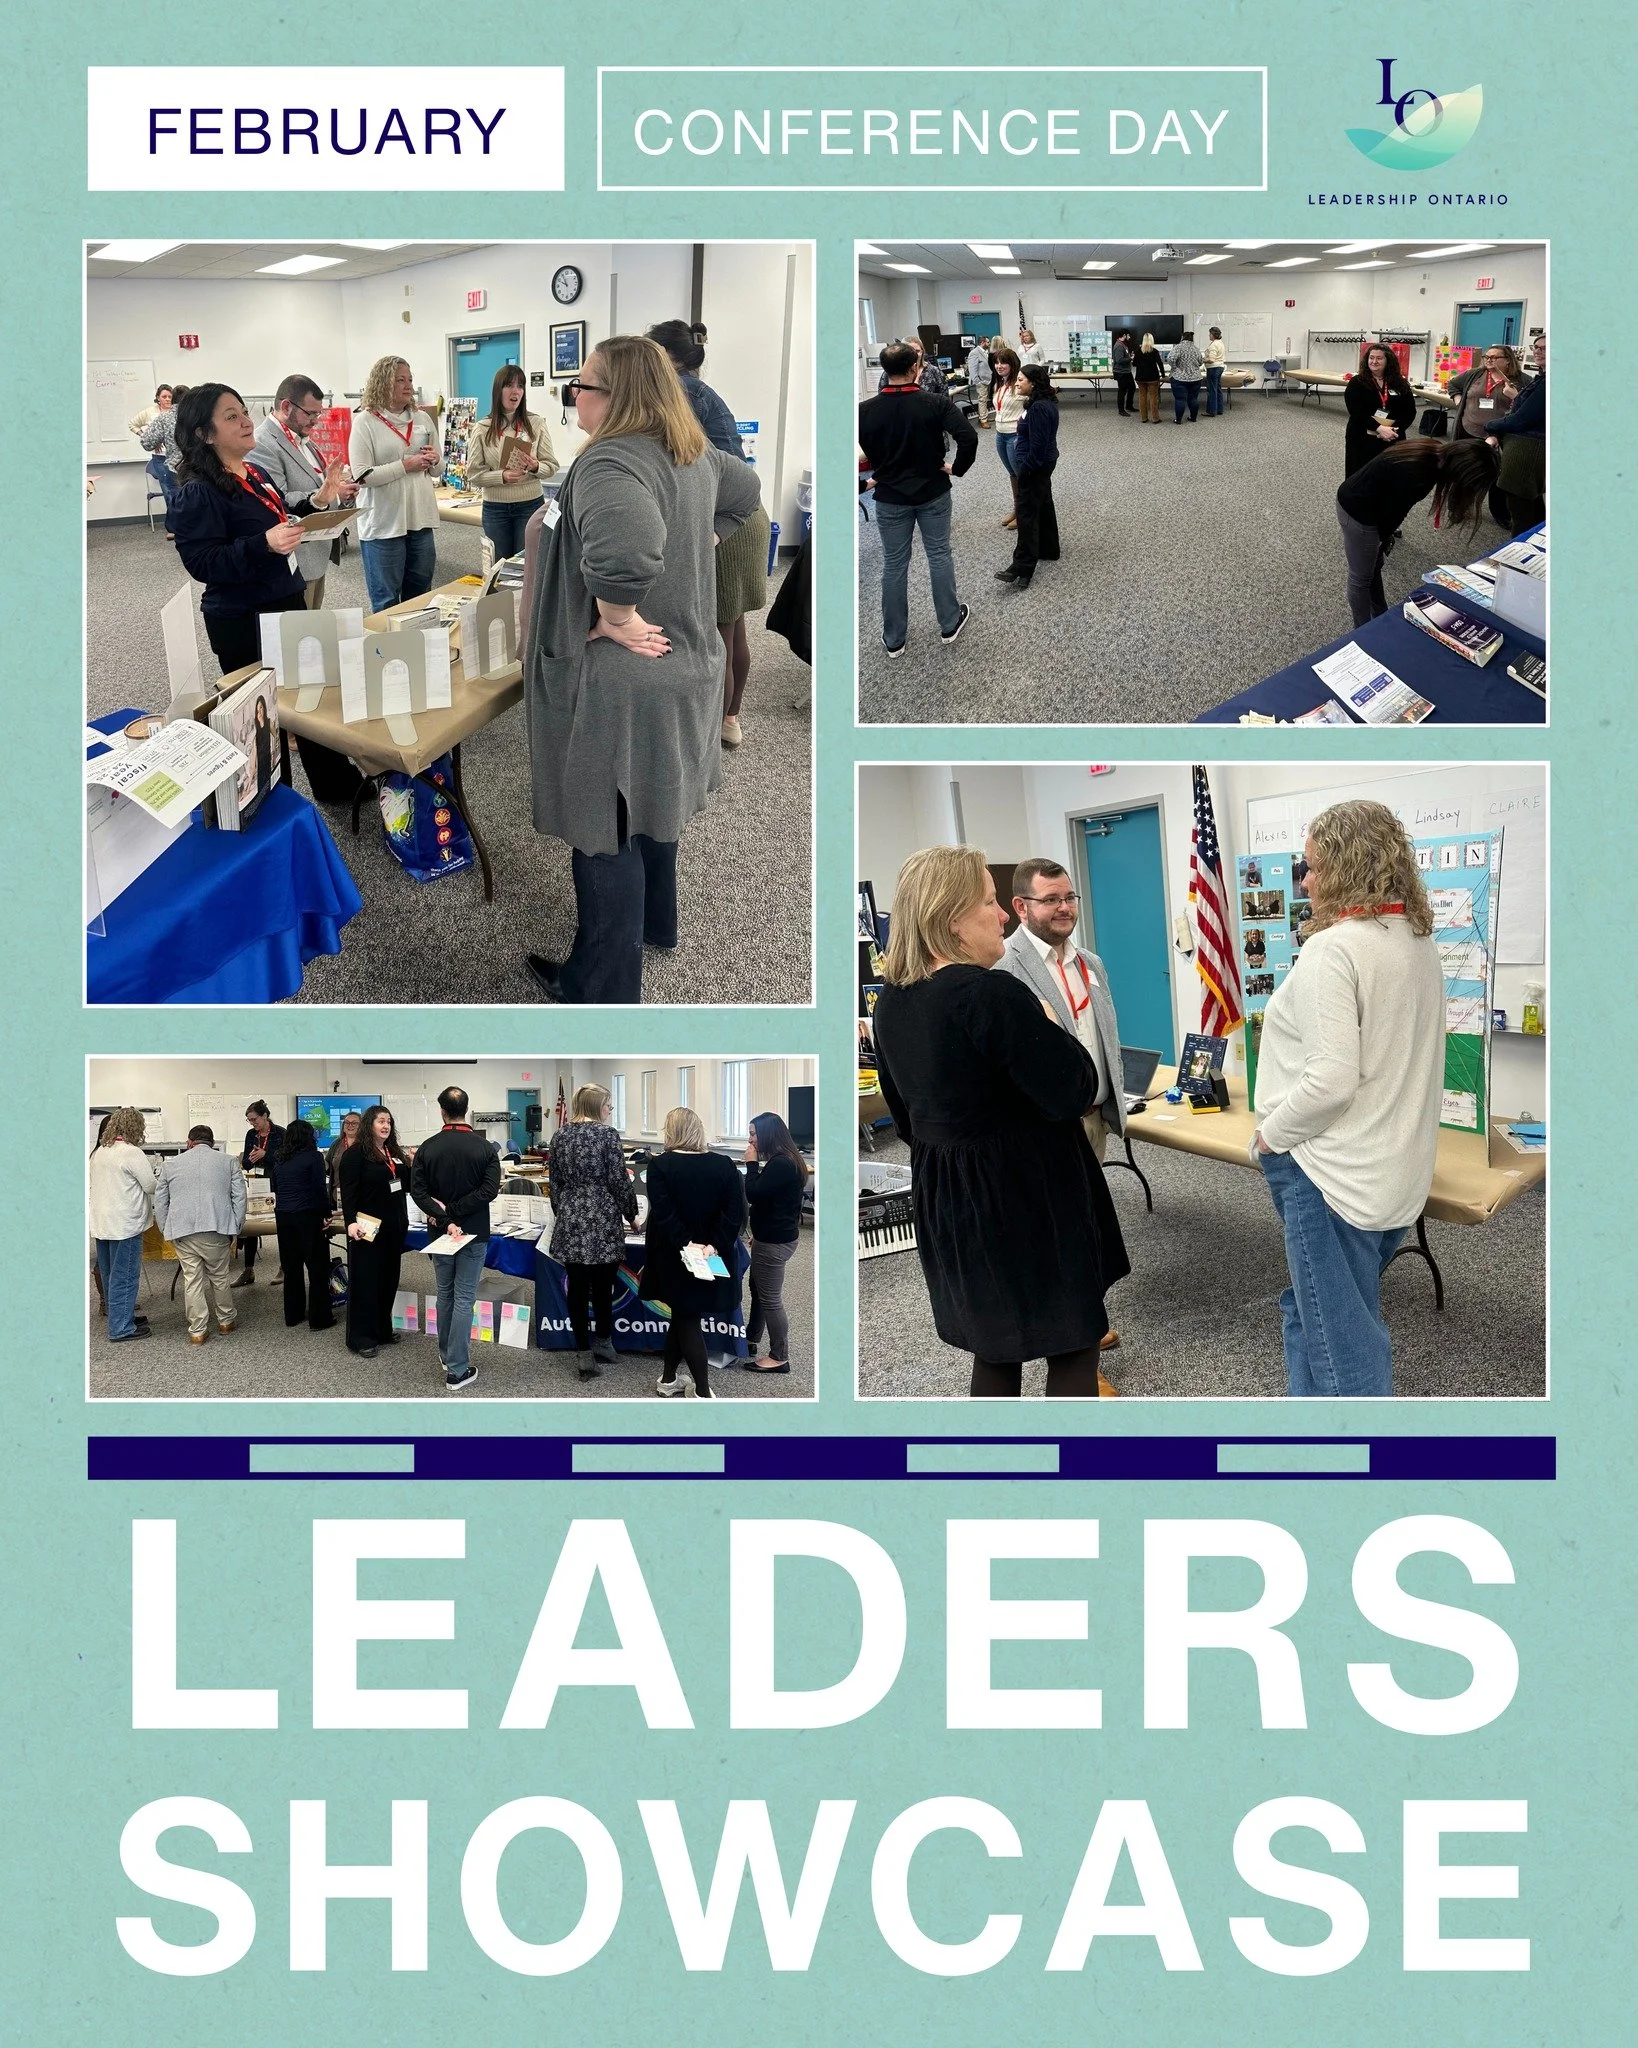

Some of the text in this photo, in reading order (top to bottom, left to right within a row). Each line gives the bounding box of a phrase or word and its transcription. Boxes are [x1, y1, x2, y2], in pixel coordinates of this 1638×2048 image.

[1478, 278, 1491, 288] EXIT
[467, 290, 481, 308] EXIT
[110, 763, 132, 781] year
[118, 764, 147, 787] fiscal
[206, 762, 224, 777] Figures
[1489, 795, 1541, 815] CLAIRE
[1415, 808, 1460, 828] Lindsay
[1255, 829, 1288, 844] Alexis
[614, 1318, 747, 1338] Conntions
